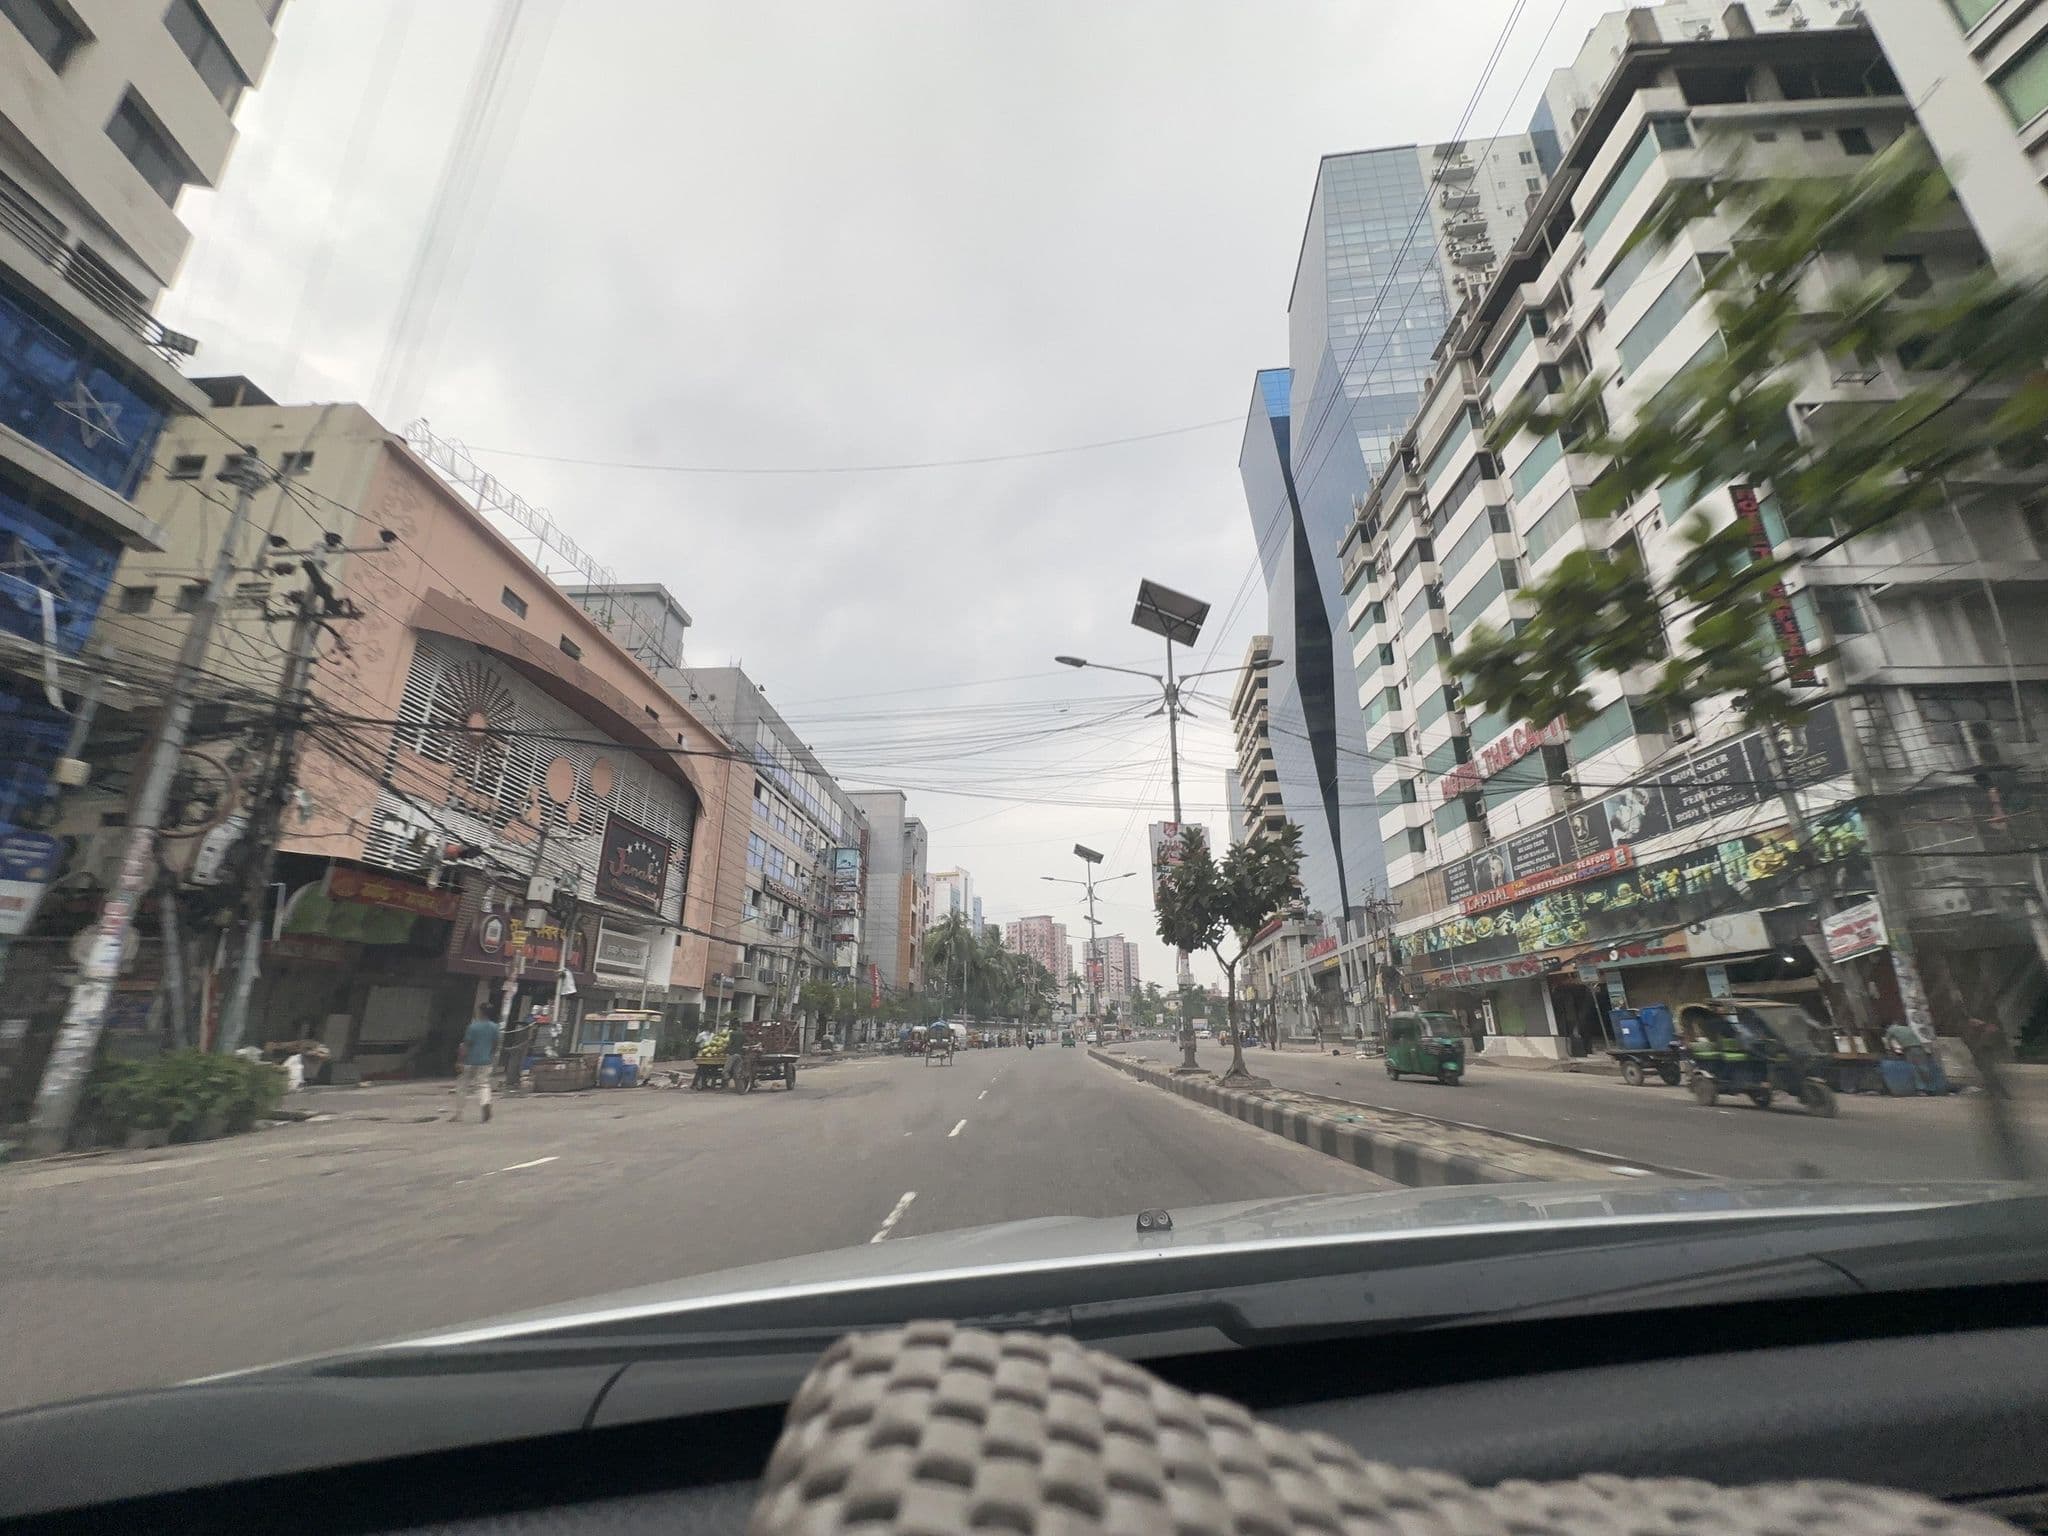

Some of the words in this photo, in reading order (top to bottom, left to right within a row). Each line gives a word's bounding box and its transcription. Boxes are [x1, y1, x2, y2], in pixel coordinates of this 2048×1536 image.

[1481, 736, 1513, 777] THE
[1676, 808, 1699, 822] BODY
[1576, 853, 1611, 869] SEAFOOD
[1466, 887, 1510, 912] CAPITAL
[1538, 872, 1577, 890] RESTAURANT
